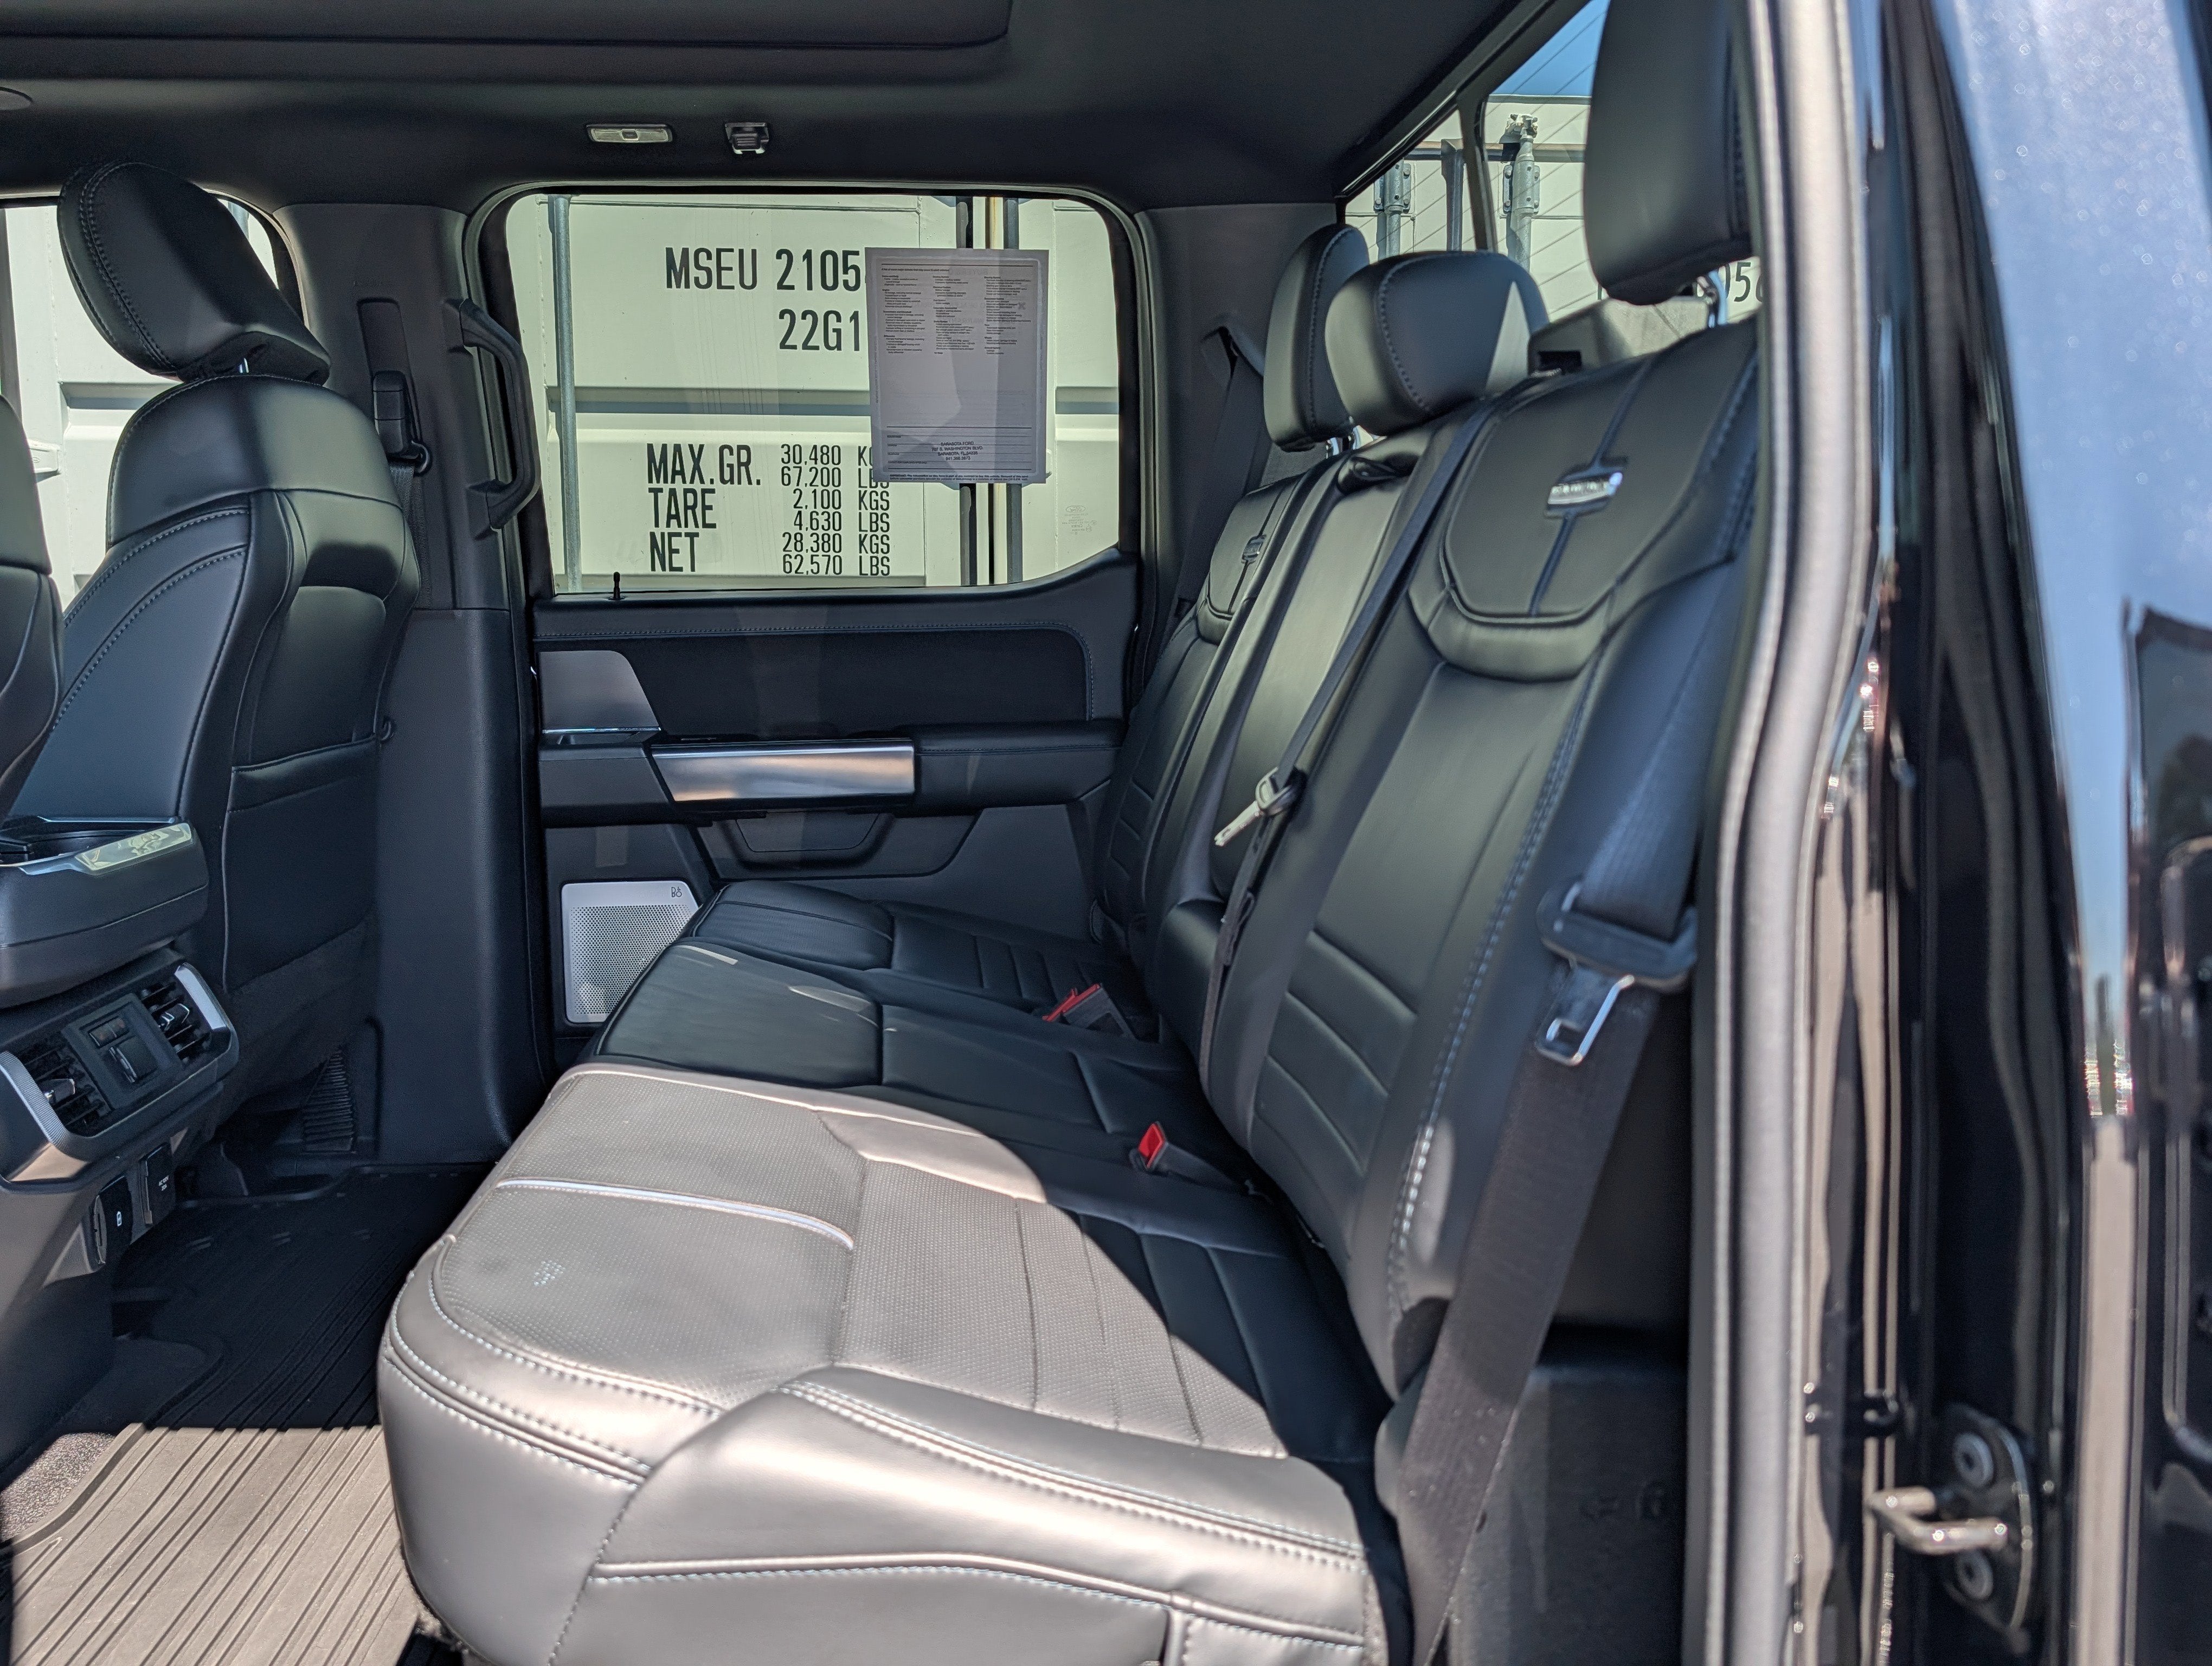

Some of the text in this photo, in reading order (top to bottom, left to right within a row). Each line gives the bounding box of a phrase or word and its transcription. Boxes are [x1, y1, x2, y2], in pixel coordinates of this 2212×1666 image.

[666, 247, 866, 291] MSEU 2105
[779, 310, 860, 351] 22G1
[647, 443, 761, 485] MAX.GR.
[781, 444, 841, 465] 30,480
[781, 466, 841, 488] 67,200
[648, 487, 717, 529] TARE
[793, 488, 890, 511] 2,100 KGS
[794, 510, 890, 533] 4,630 LBS
[650, 531, 700, 572] NET
[782, 532, 890, 554] 28,380 KGS
[783, 554, 890, 576] 62,570 LBS
